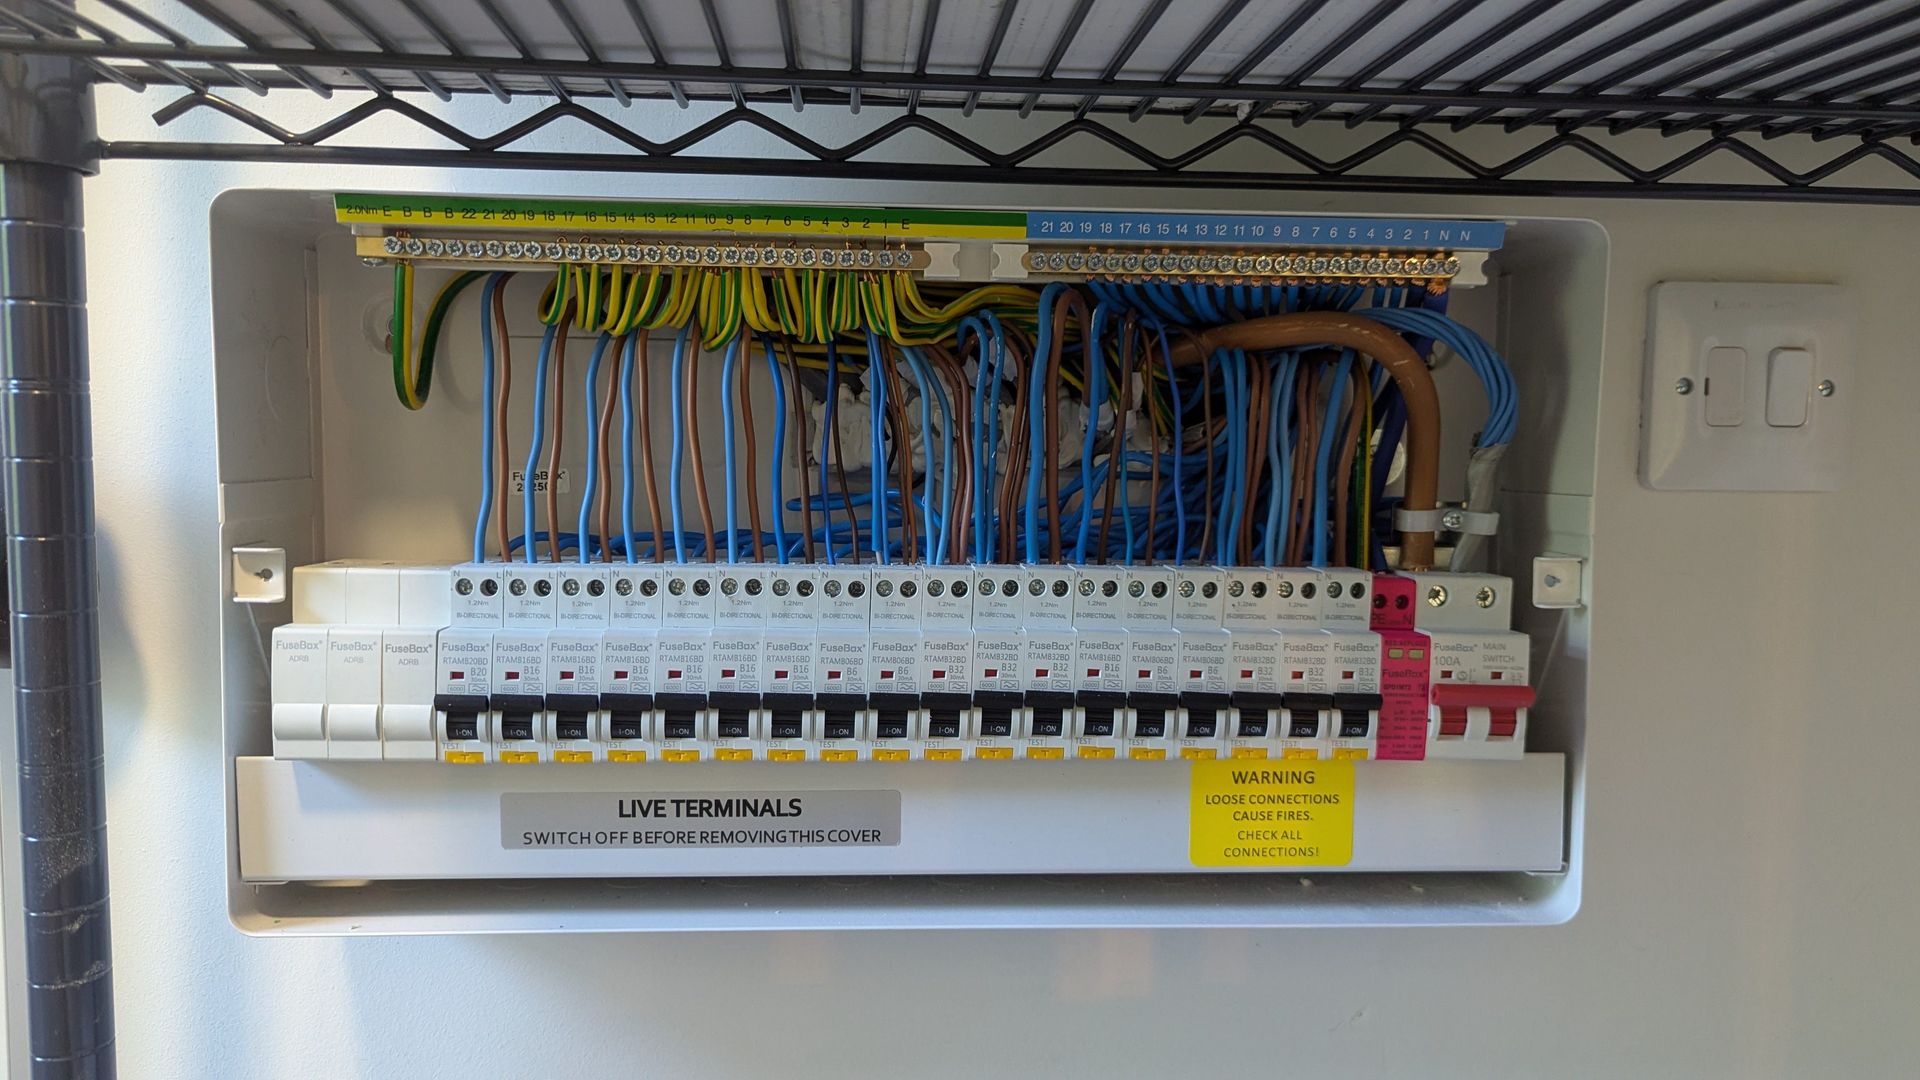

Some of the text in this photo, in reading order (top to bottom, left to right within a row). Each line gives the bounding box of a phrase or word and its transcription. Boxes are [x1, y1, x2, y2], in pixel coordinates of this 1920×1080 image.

[383, 206, 392, 216] E
[404, 206, 412, 217] B
[424, 207, 432, 217] B
[445, 208, 454, 218] B
[462, 209, 477, 219] 22
[483, 209, 496, 219] 21
[502, 209, 516, 220] 20
[522, 210, 535, 220] 19
[542, 211, 555, 221] 18
[563, 211, 575, 221] 17
[584, 212, 596, 222] 16
[603, 212, 616, 222] 15
[623, 212, 635, 223] 14
[643, 213, 656, 223] 13
[665, 213, 677, 224] 12
[685, 213, 696, 224] 11
[704, 214, 716, 224] 10
[726, 214, 733, 224] 9
[744, 215, 752, 225] 8
[764, 215, 771, 226] 7
[784, 216, 791, 226] 6
[803, 216, 811, 226] 5
[822, 217, 829, 227] 4
[842, 217, 849, 228] 3
[862, 218, 870, 228] 2
[884, 219, 887, 228] 1
[902, 219, 910, 229] E
[1041, 222, 1471, 241] 21 20 19 18 17 16 15 14 13 12 11 10 9 8 7 6 5 4 3 2 1 N N
[513, 471, 565, 480] FueBx
[1435, 656, 1460, 665] 100A
[524, 667, 540, 675] B16
[578, 666, 594, 674] B16
[633, 666, 648, 674] B16
[740, 664, 755, 672] B16
[793, 665, 809, 673] B16
[949, 666, 964, 674] B32
[1002, 663, 1016, 671] B32
[1053, 663, 1068, 671] B32
[1105, 663, 1119, 671] B16
[1208, 666, 1218, 674] B6
[1258, 667, 1273, 675] B32
[470, 668, 487, 676] B20
[1309, 668, 1323, 676] B32
[1359, 668, 1374, 676] B32
[1232, 771, 1315, 784] WARNING
[1206, 794, 1339, 805] LOOSE CONNECTIONS
[618, 798, 801, 818] LIVE TERMINALS
[1233, 811, 1313, 821] CAUSE FIRES.
[523, 829, 881, 845] SWITCH OFF BEFORE REMOVING THIS COVER
[1238, 830, 1302, 840] CHECK ALL
[1224, 847, 1319, 857] CONNECTIONS!
